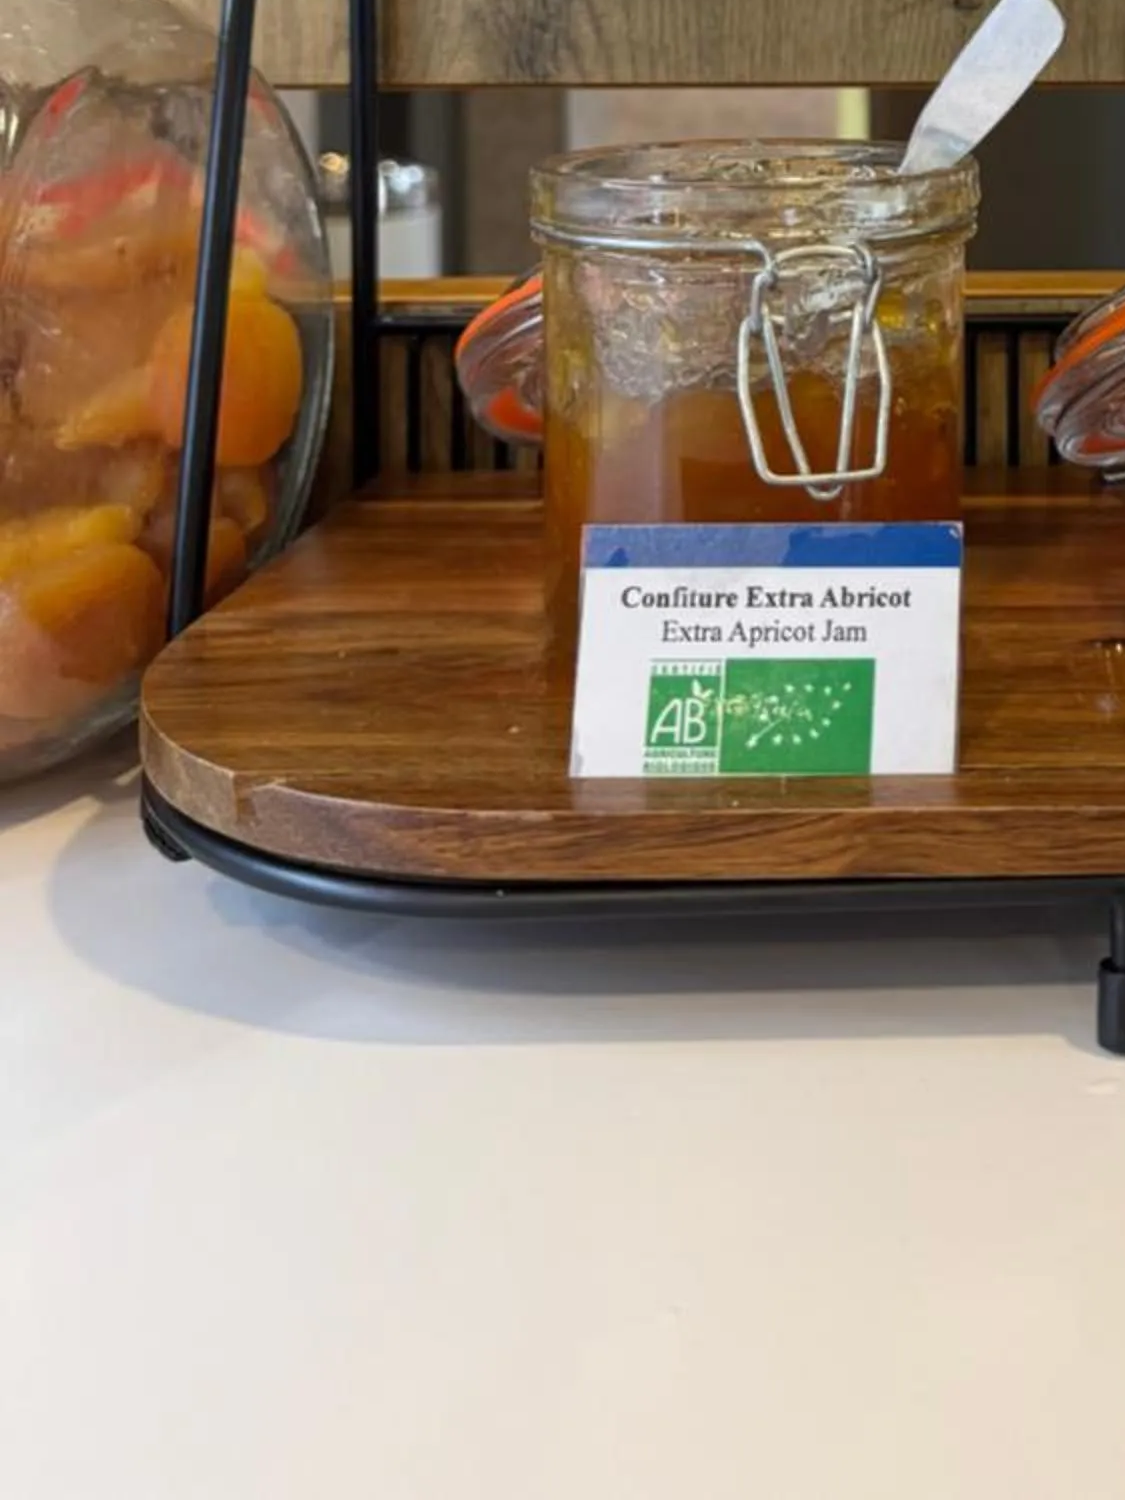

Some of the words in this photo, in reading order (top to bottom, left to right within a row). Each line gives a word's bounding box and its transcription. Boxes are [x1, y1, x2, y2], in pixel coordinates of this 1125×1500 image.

[620, 586, 739, 609] Confiture
[746, 586, 814, 609] Extra
[819, 586, 912, 609] Abricot
[661, 619, 723, 643] Extra
[727, 619, 816, 649] Apricot
[821, 619, 868, 643] Jam
[650, 698, 707, 744] AB
